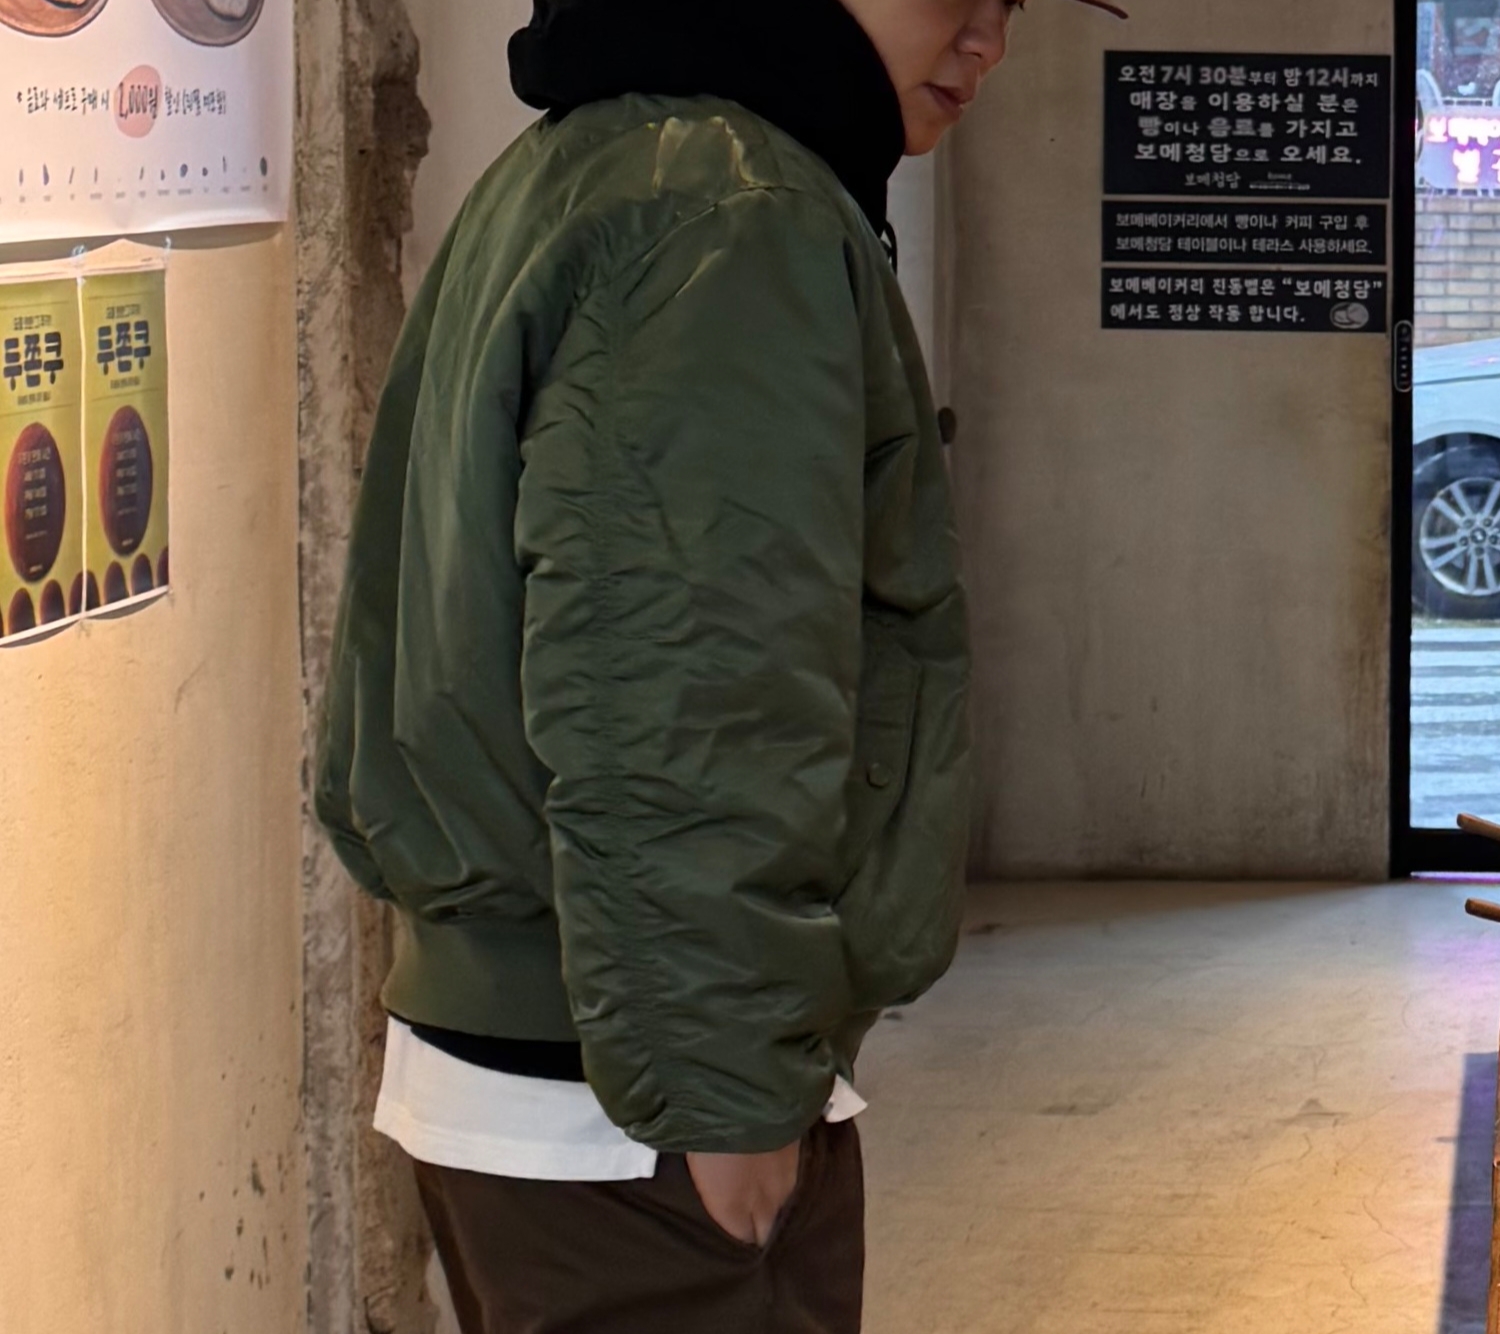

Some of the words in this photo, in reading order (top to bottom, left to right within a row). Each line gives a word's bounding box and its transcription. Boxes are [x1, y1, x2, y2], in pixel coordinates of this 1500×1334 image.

[1118, 64, 1155, 84] 오전
[1160, 64, 1192, 86] 7시
[1199, 65, 1276, 86] 30분부터
[1283, 67, 1302, 87] 밤
[1305, 66, 1378, 88] 12시까지
[1129, 90, 1198, 112] 매장을
[1208, 92, 1303, 113] 이용하실
[1316, 93, 1359, 114] 분은
[1138, 116, 1199, 137] 빵이나
[1207, 117, 1275, 138] 음료를
[1285, 119, 1358, 139] 가지고
[1134, 143, 1270, 163] 보메청담으로
[1280, 145, 1361, 165] 오세요.
[1185, 171, 1241, 189] 보메청담
[1116, 213, 1228, 229] 보메베이커리에서
[1234, 214, 1278, 230] 빵이나
[1284, 215, 1313, 230] 커피
[1319, 215, 1348, 231] 구입
[1116, 236, 1172, 252] 보메청담
[1177, 236, 1247, 253] 테이블이나
[1252, 238, 1295, 253] 테라스
[1109, 277, 1204, 295] 보메베이커리
[1213, 277, 1276, 296] 진동벨은
[1110, 303, 1161, 321] 에서도
[1169, 304, 1201, 322] 정상
[1209, 304, 1241, 323] 작동
[1249, 305, 1305, 323] 합니다.
[97, 320, 151, 376] 두쫀쿠
[4, 332, 64, 391] 두쫀쿠
